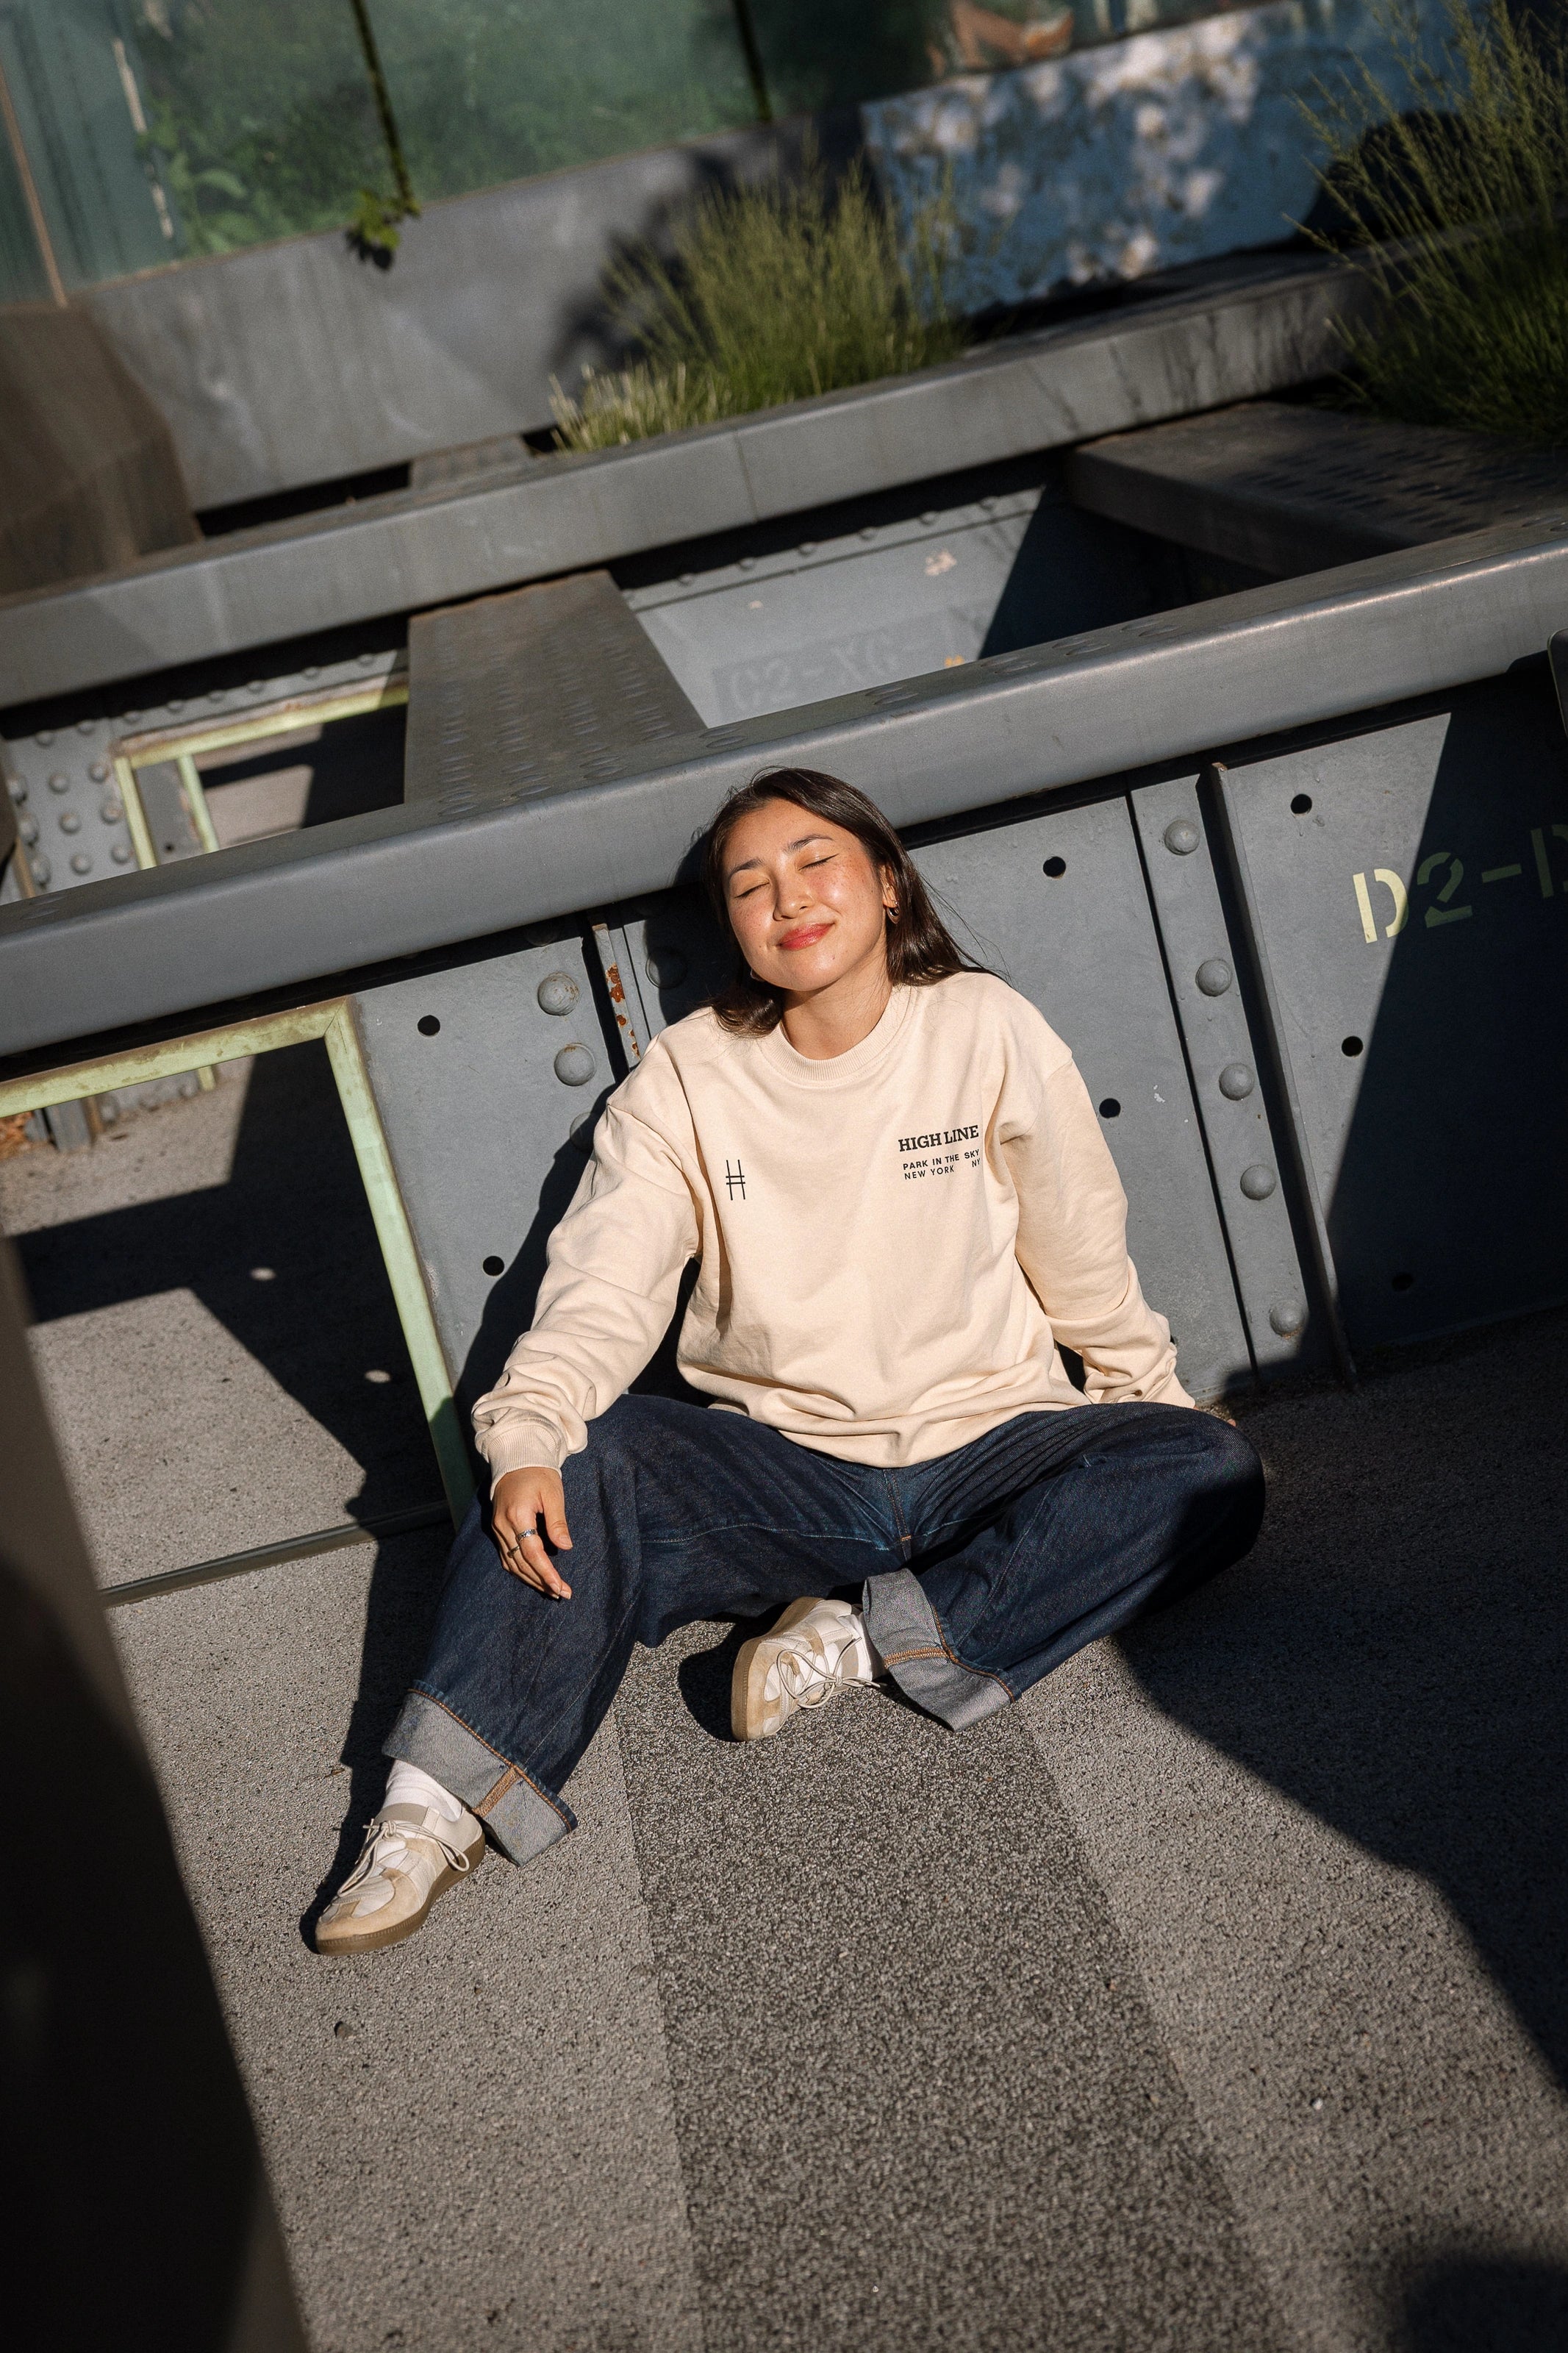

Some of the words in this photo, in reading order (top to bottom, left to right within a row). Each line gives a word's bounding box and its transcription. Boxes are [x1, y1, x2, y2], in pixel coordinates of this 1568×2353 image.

[898, 1132, 942, 1152] HIGH
[944, 1124, 979, 1145] LINE
[903, 1160, 928, 1171] PARK
[932, 1157, 942, 1165] IN
[945, 1154, 960, 1163] THE
[964, 1149, 980, 1159] SKY
[904, 1169, 926, 1180] NEW
[930, 1165, 955, 1176] YORK
[971, 1157, 981, 1168] NY
